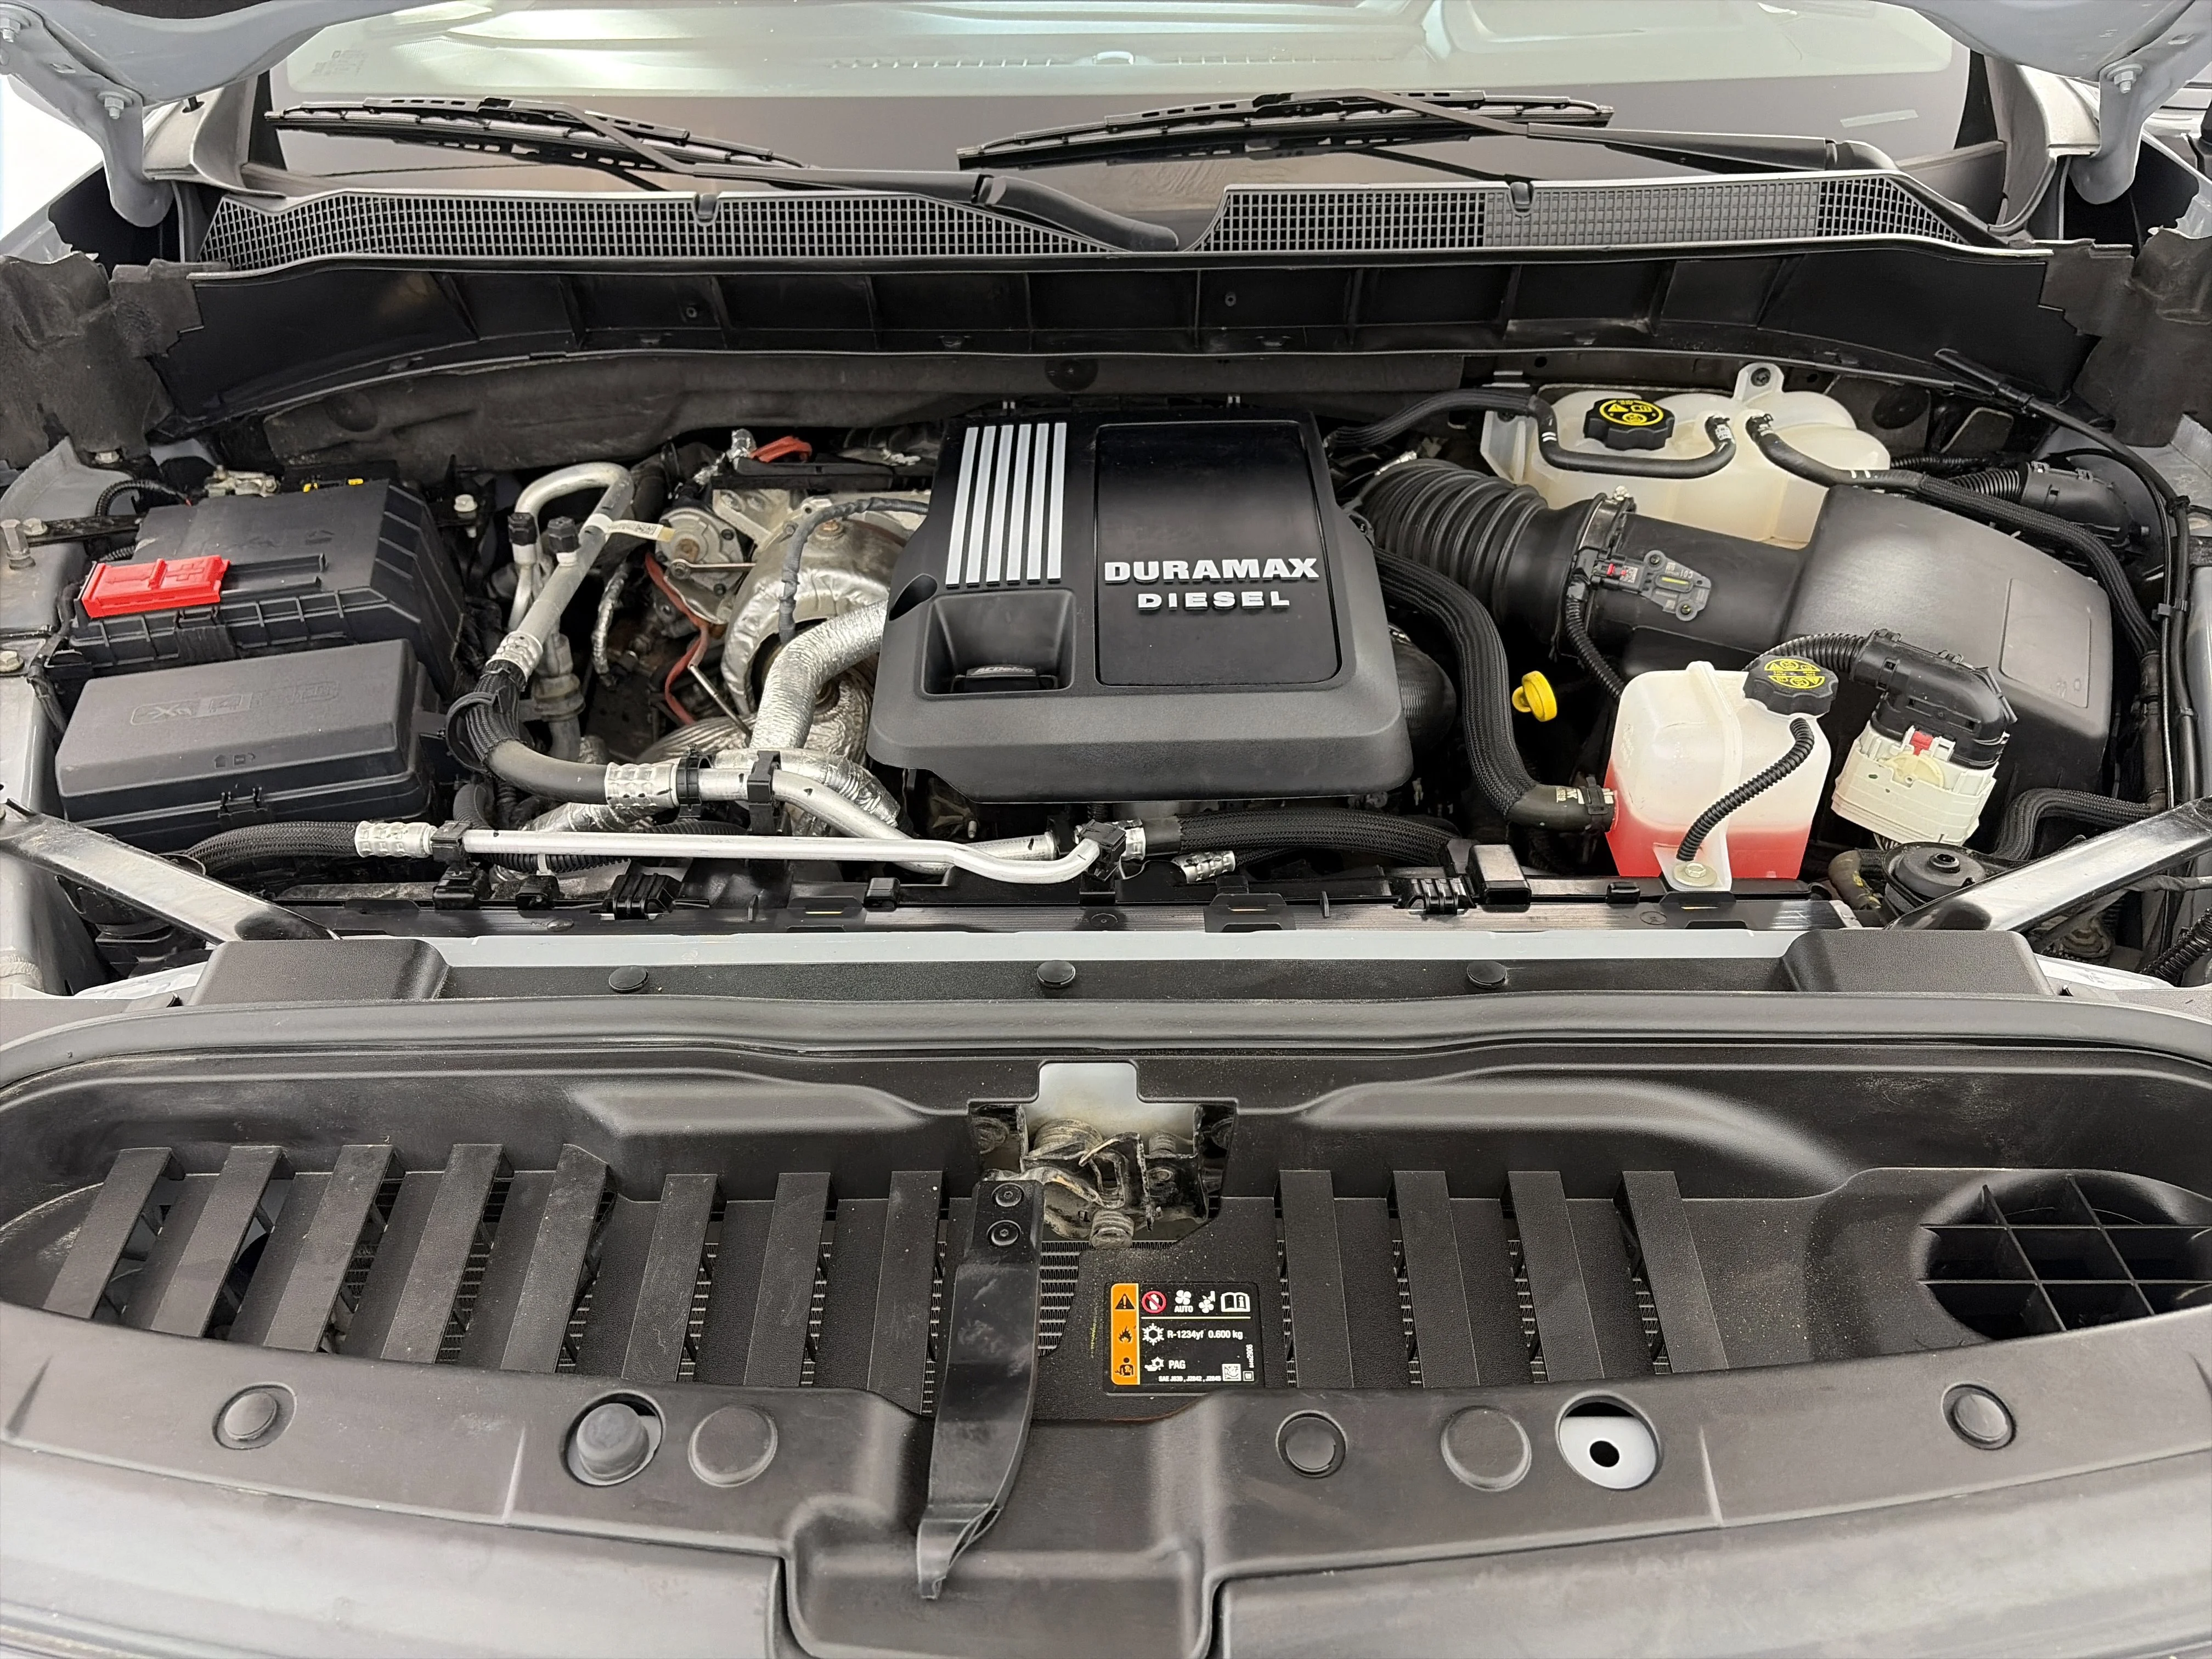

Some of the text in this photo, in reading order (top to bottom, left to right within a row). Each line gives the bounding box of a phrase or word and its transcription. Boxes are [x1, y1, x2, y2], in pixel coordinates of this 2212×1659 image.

[1104, 558, 1319, 583] DURAMAX
[1138, 591, 1290, 610] DIESEL
[1167, 1330, 1243, 1340] R-1234yf 0.600 kg
[1169, 1360, 1186, 1370] PAG
